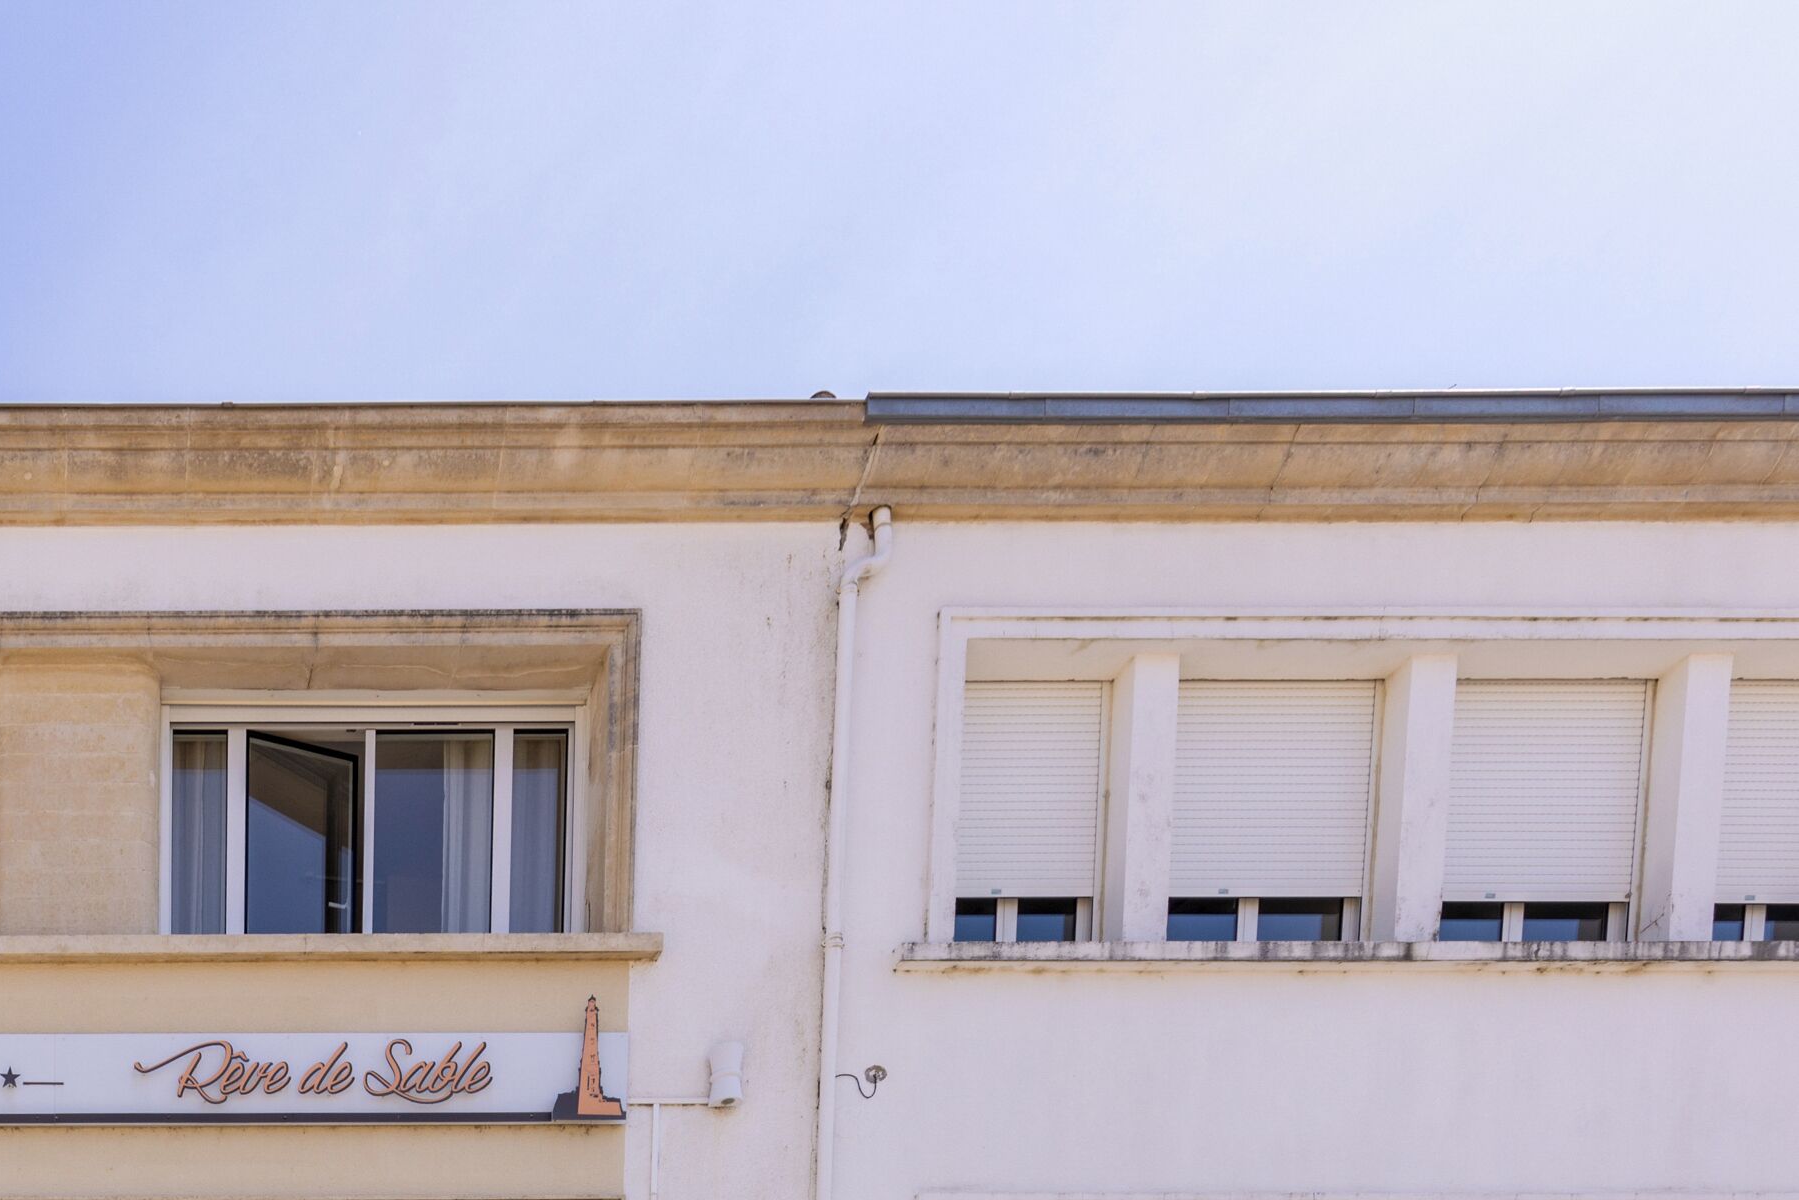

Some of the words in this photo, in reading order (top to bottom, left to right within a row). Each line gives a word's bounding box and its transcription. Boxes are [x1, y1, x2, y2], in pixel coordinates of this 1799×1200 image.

[134, 1038, 289, 1104] Rêve
[298, 1041, 353, 1095] de
[363, 1037, 494, 1105] Sable
